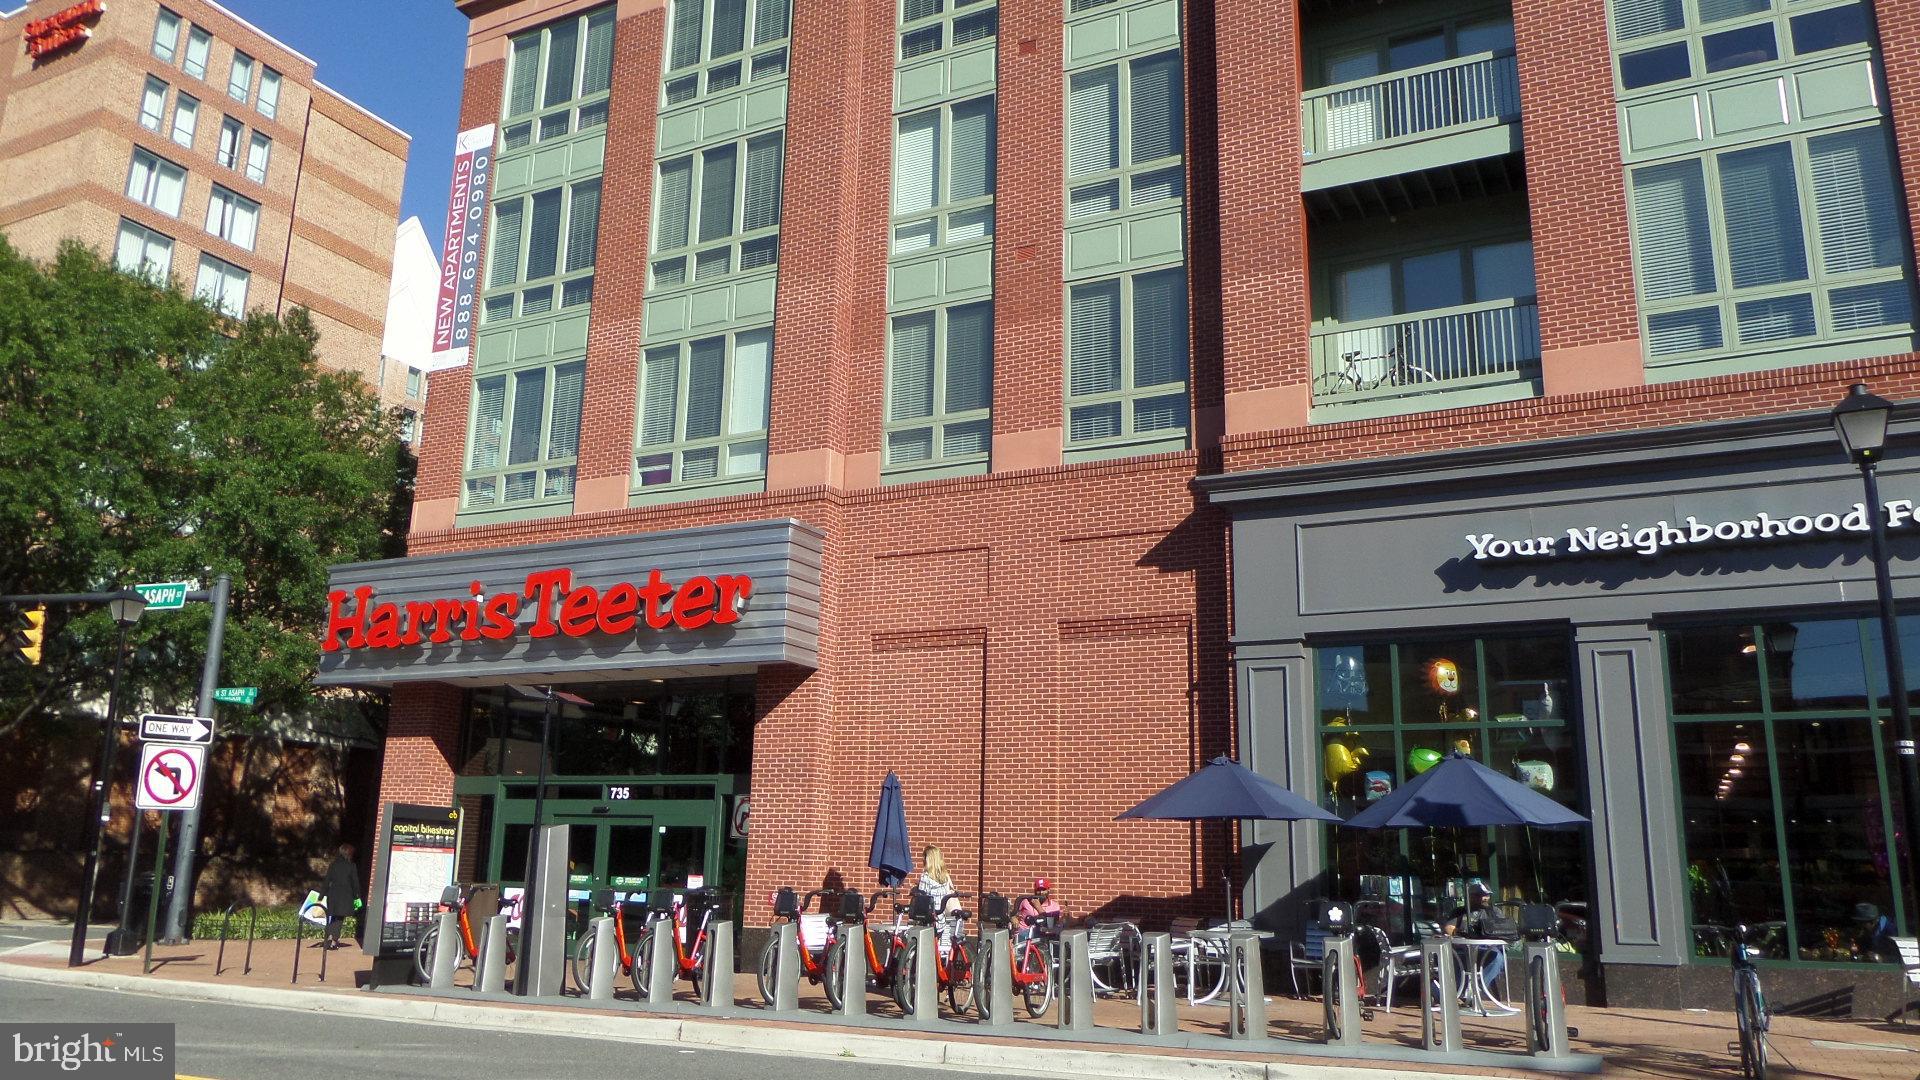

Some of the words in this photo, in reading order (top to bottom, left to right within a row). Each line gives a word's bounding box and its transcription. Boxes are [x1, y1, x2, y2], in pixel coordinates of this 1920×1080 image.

[443, 160, 470, 290] APARTMENTS
[455, 156, 488, 340] 888.694.0980
[436, 297, 453, 345] NEW
[1465, 533, 1555, 560] Your
[1566, 502, 1871, 555] Neighborhood
[1884, 499, 1920, 527] F
[144, 588, 176, 604] ASAPH
[320, 580, 519, 652] Harris
[523, 568, 755, 638] Teeter
[228, 689, 246, 697] ASAPH
[148, 722, 168, 733] ONE
[172, 724, 191, 734] WAY
[610, 787, 630, 800] 735
[393, 824, 420, 835] capital
[420, 824, 455, 836] bikeshare
